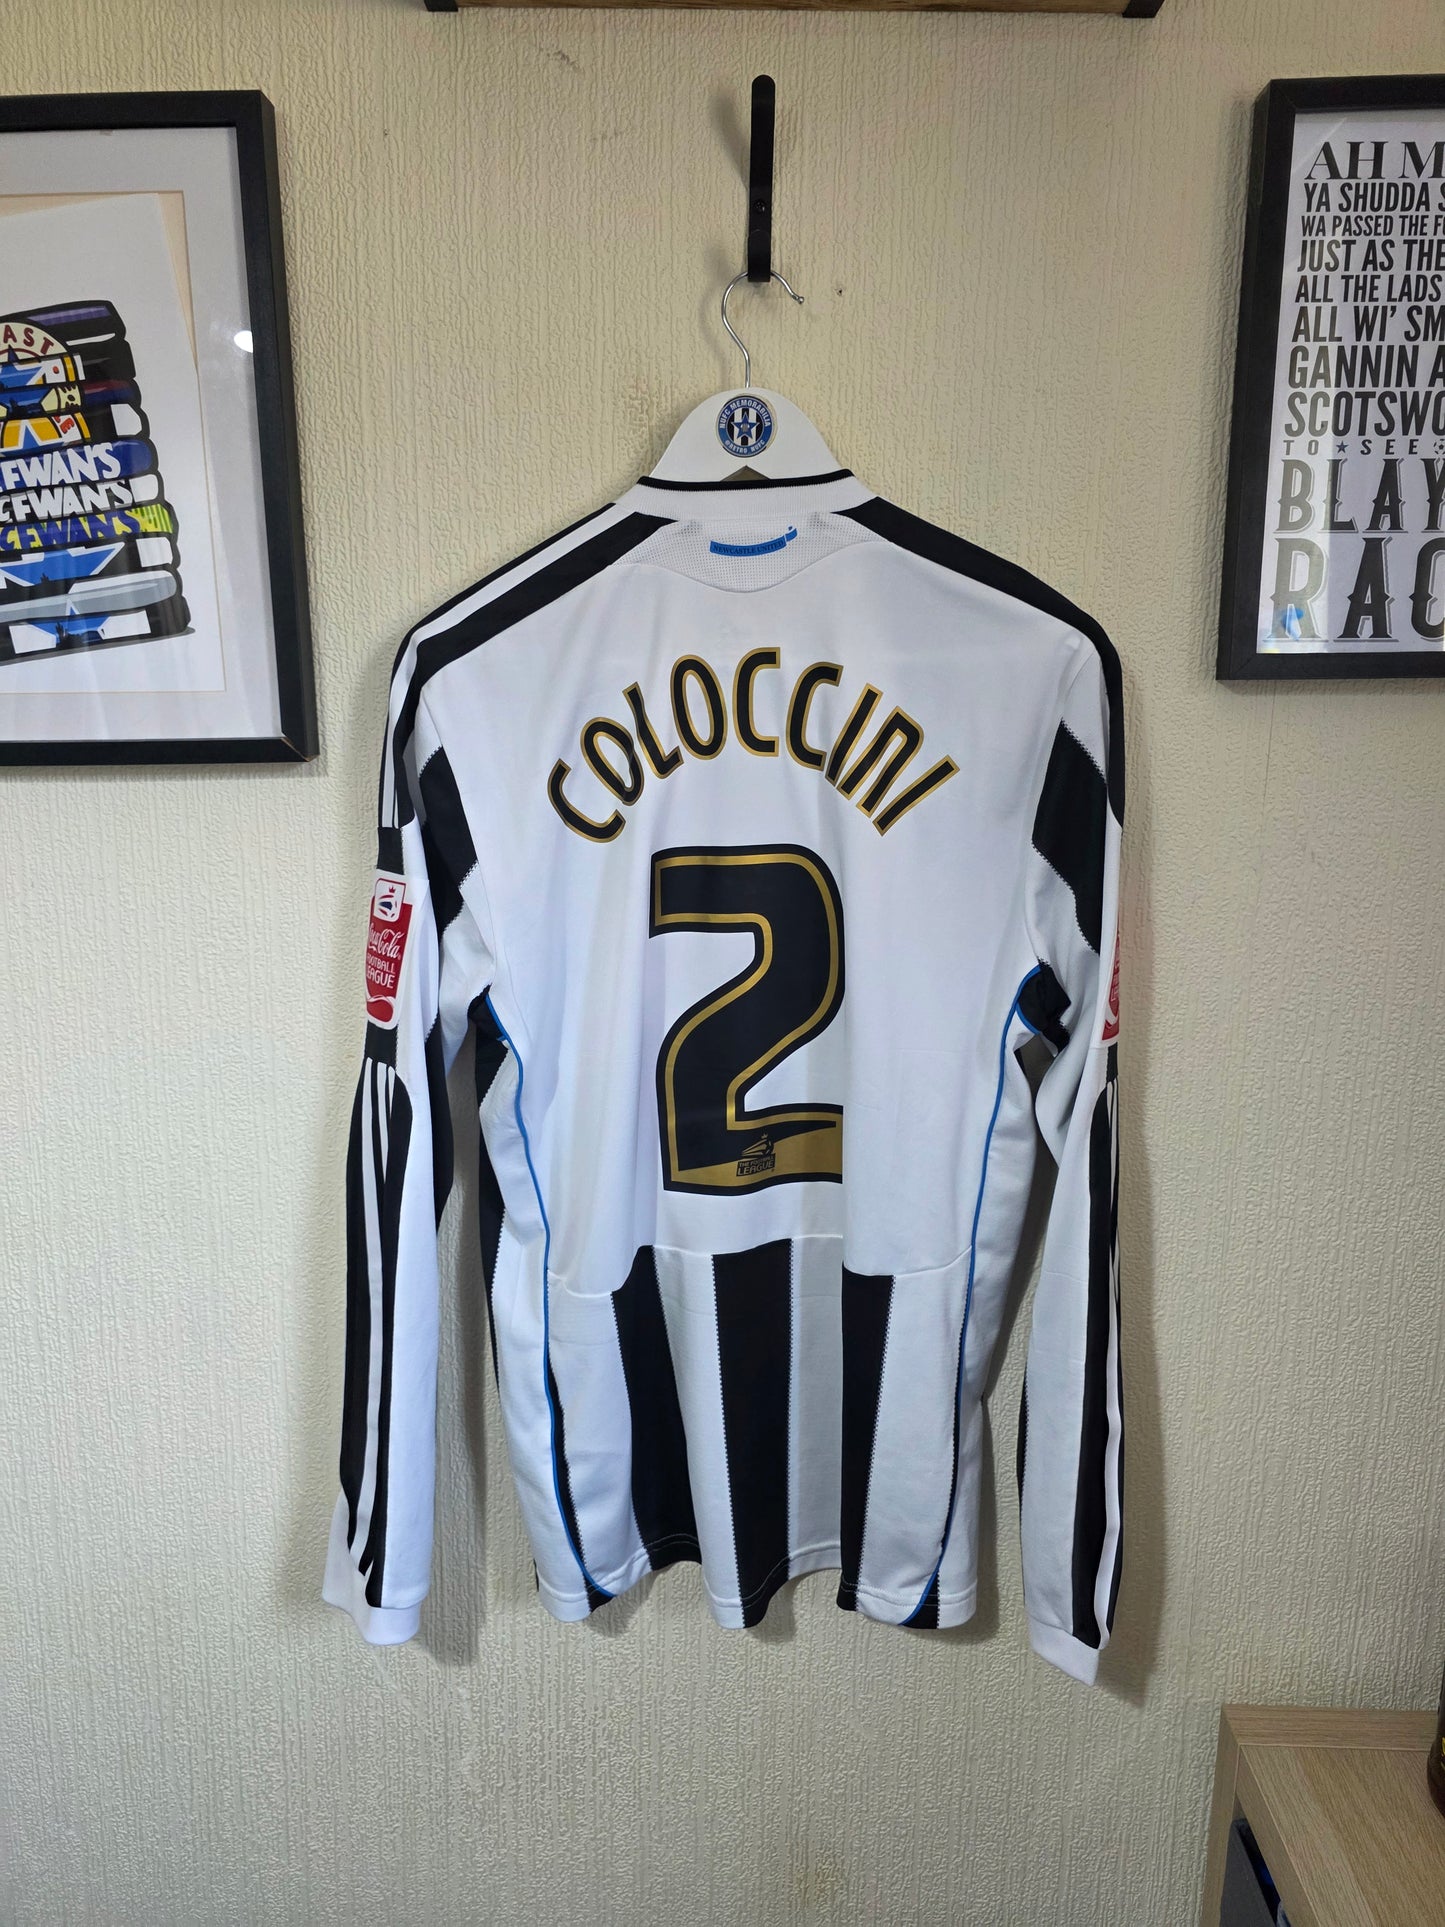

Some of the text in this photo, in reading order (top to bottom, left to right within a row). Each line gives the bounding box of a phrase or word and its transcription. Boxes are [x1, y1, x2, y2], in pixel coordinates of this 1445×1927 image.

[1304, 141, 1388, 180] AH
[1304, 182, 1331, 212] YA
[1338, 182, 1430, 212] SHUDDA
[1301, 215, 1326, 237] WA
[1332, 215, 1393, 236] PASSED
[1399, 215, 1429, 236] THE
[1297, 239, 1356, 272] JUST
[1361, 239, 1395, 272] AS
[1295, 274, 1443, 303] ALL THE LADS
[1292, 306, 1343, 342] ALL
[1288, 345, 1419, 388] GANNIN
[730, 399, 771, 427] MEMORABILIA
[1283, 438, 1419, 456] TO SEE
[713, 540, 784, 555] NEWCASTLE UNITED
[547, 647, 960, 844] COLOCCINI
[649, 844, 845, 1196] 2
[738, 1159, 775, 1176] LEAGUE
